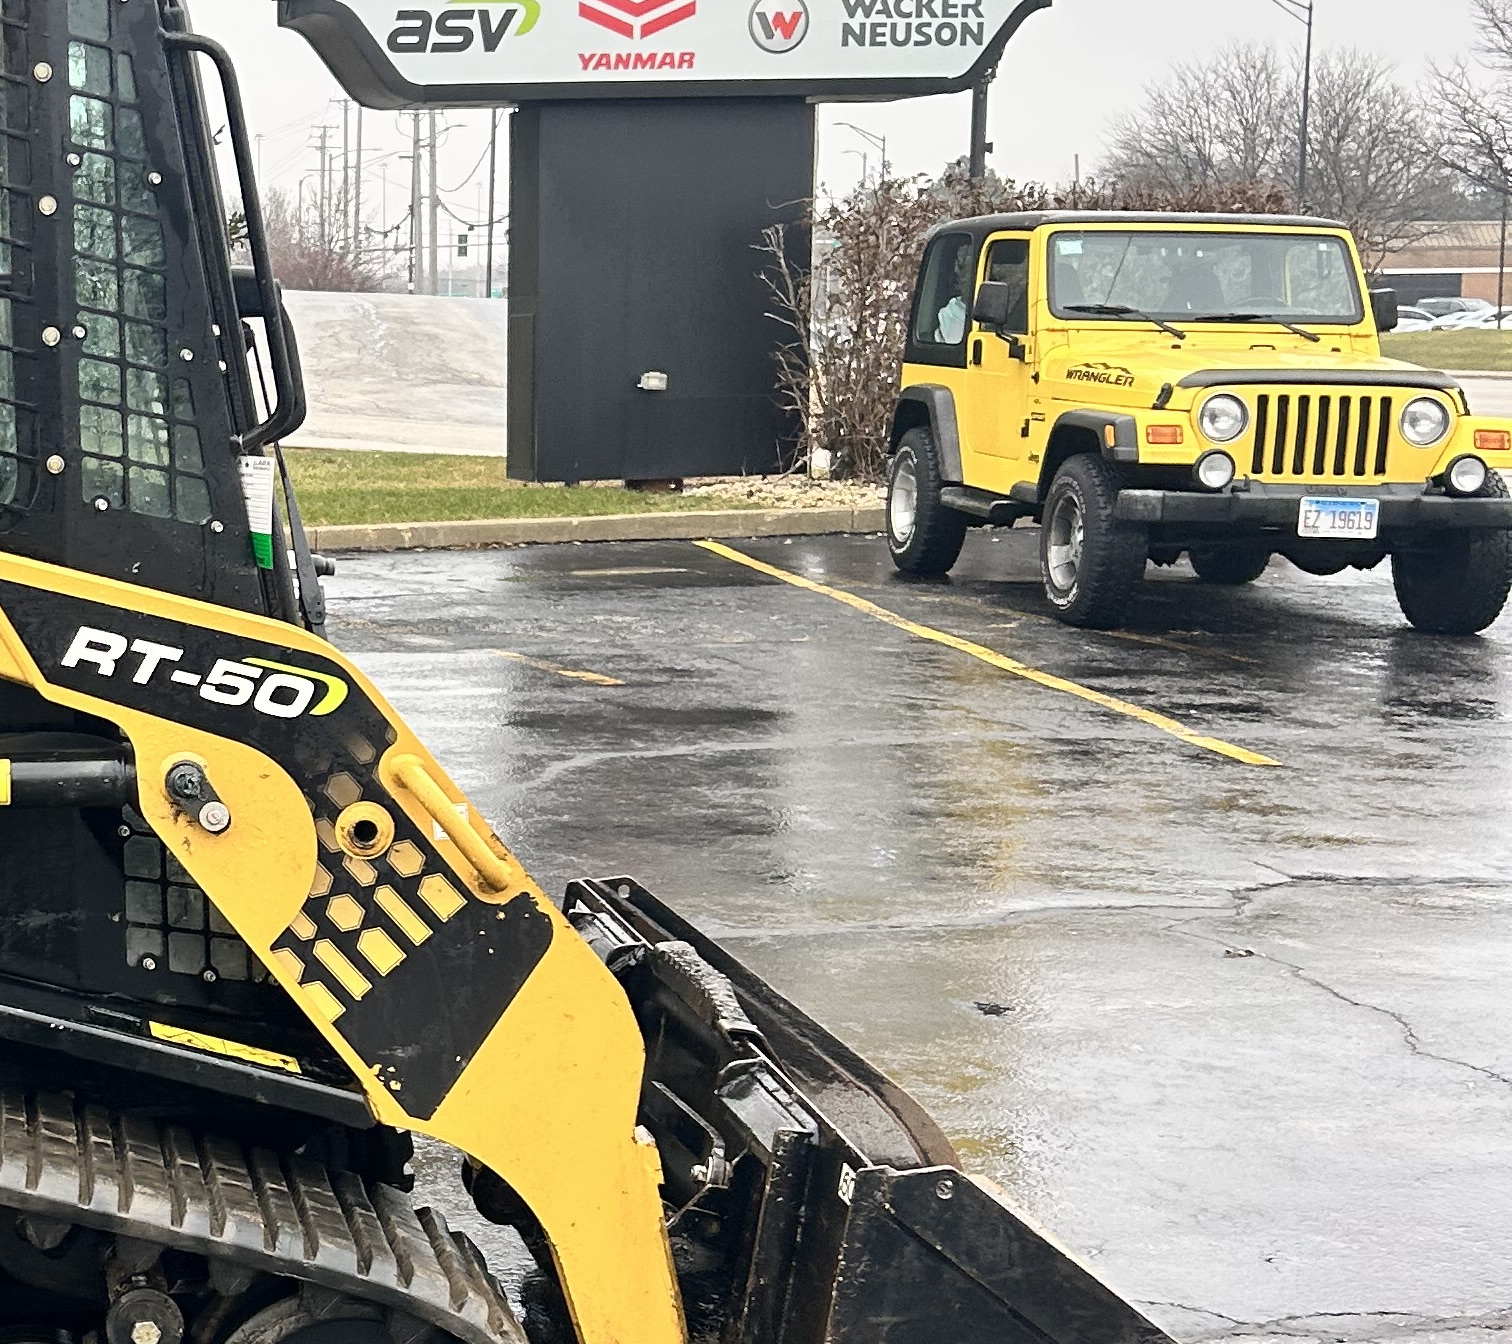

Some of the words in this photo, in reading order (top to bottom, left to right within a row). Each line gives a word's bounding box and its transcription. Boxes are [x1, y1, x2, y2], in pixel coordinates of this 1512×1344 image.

[840, 21, 985, 47] NEUSON
[578, 52, 695, 71] YANMAR
[1065, 368, 1136, 387] WRANGLER
[1303, 509, 1321, 529] EZ
[1329, 510, 1373, 531] 19619
[60, 625, 316, 719] RT-50
